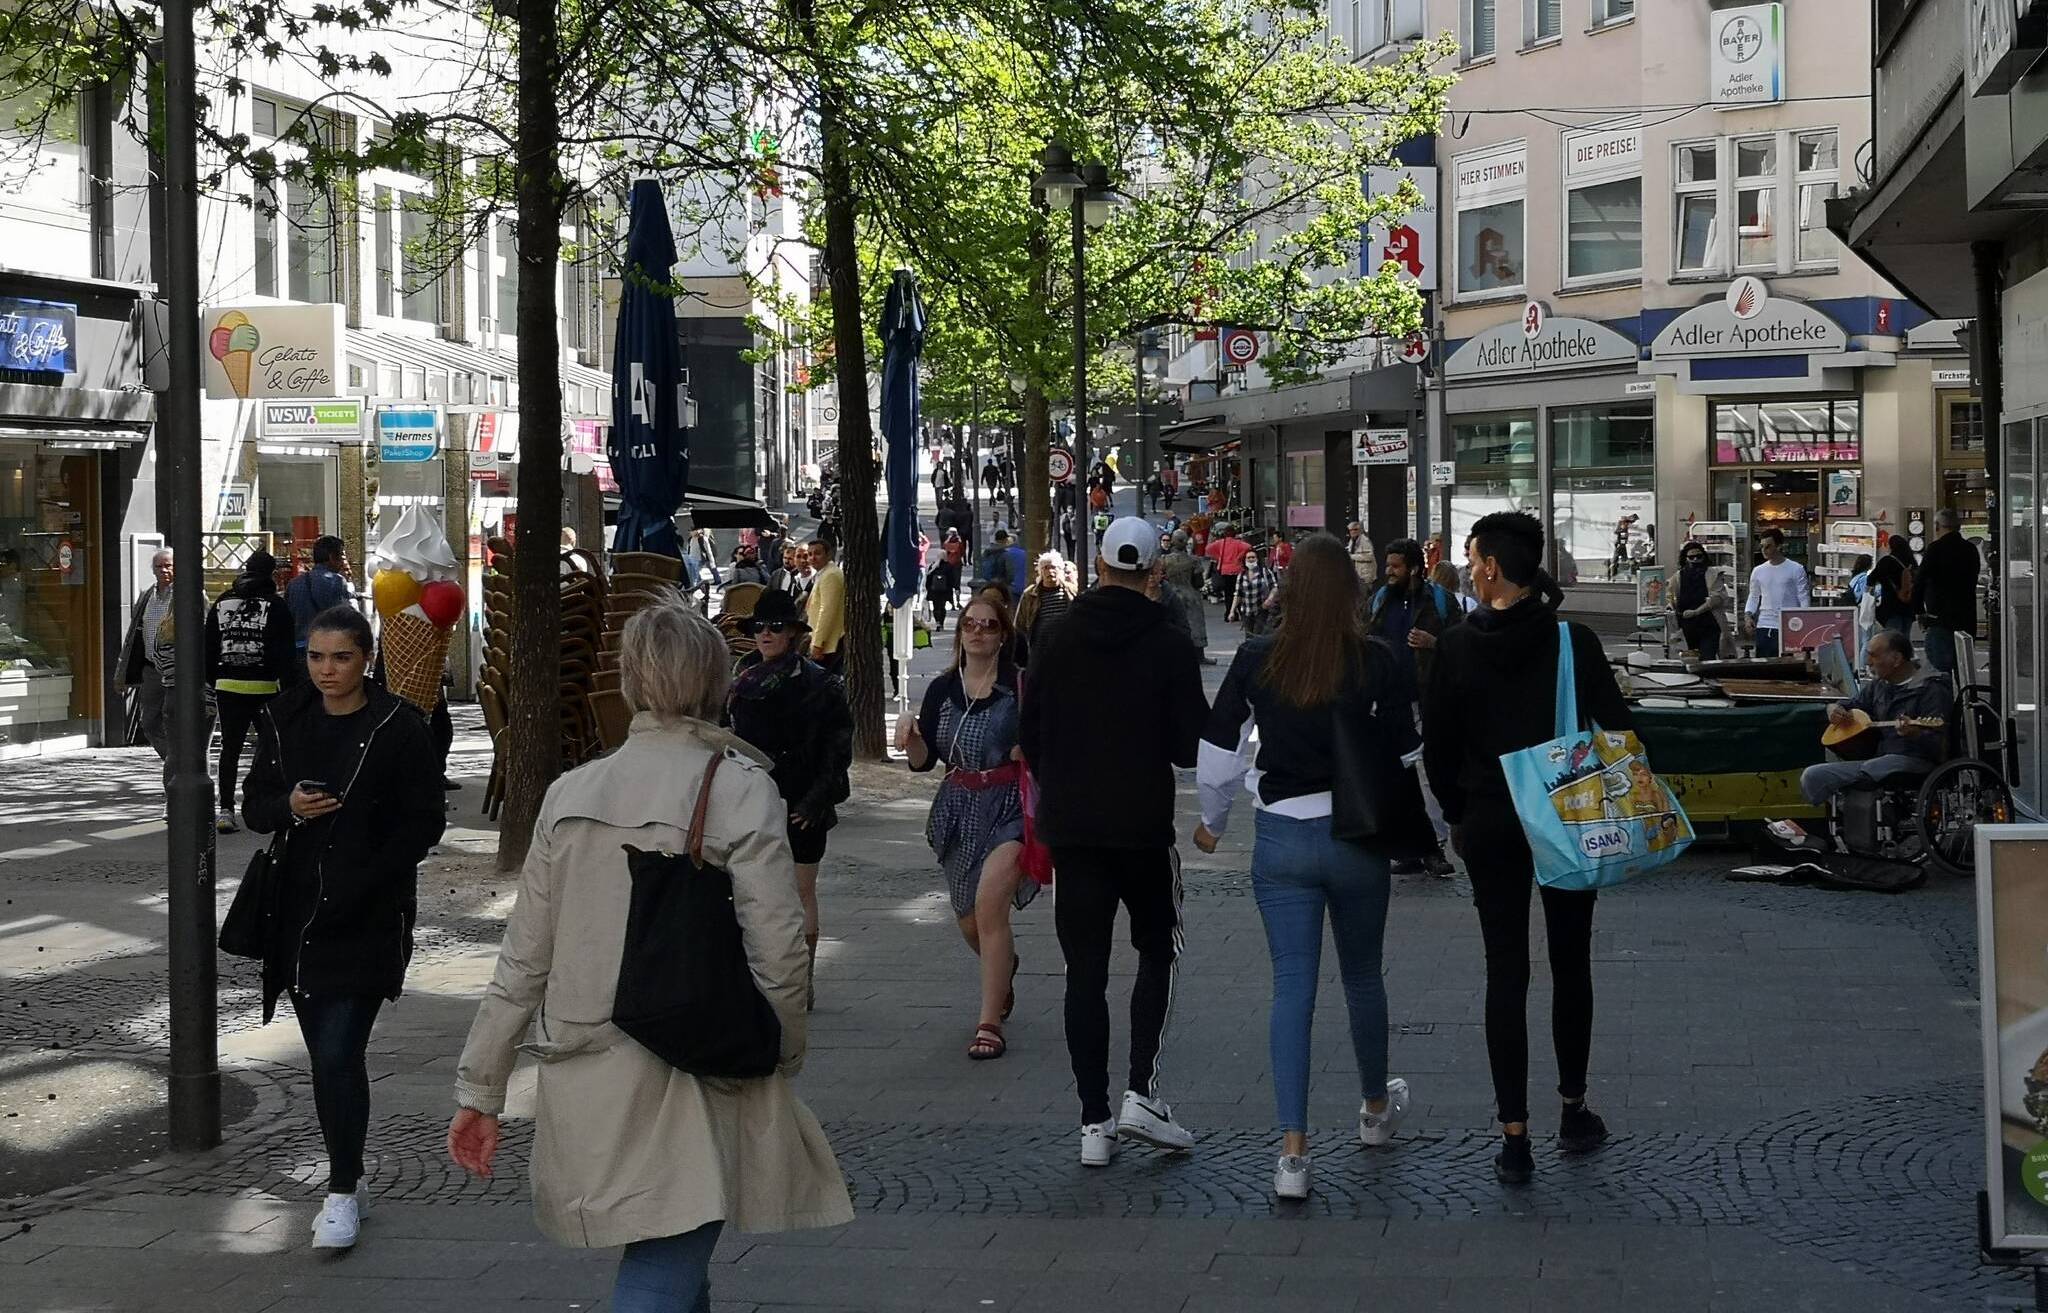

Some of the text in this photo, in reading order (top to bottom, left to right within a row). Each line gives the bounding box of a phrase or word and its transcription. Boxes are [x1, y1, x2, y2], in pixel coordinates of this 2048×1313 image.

[1723, 34, 1759, 46] BAYER
[1737, 20, 1745, 60] BAYER
[1720, 84, 1763, 97] Apotheke
[1729, 73, 1753, 83] Adler
[1577, 137, 1637, 162] DIE PREISE!
[1460, 161, 1525, 186] HIER STIMMEN
[1670, 319, 1827, 349] Adler Apotheke
[259, 346, 318, 376] Gelato
[1477, 329, 1597, 370] Adler Apotheke
[267, 367, 330, 392] & Caffe
[269, 408, 355, 422] WSW TICKETS
[395, 431, 433, 441] Hermes
[1584, 831, 1622, 851] ISANA
